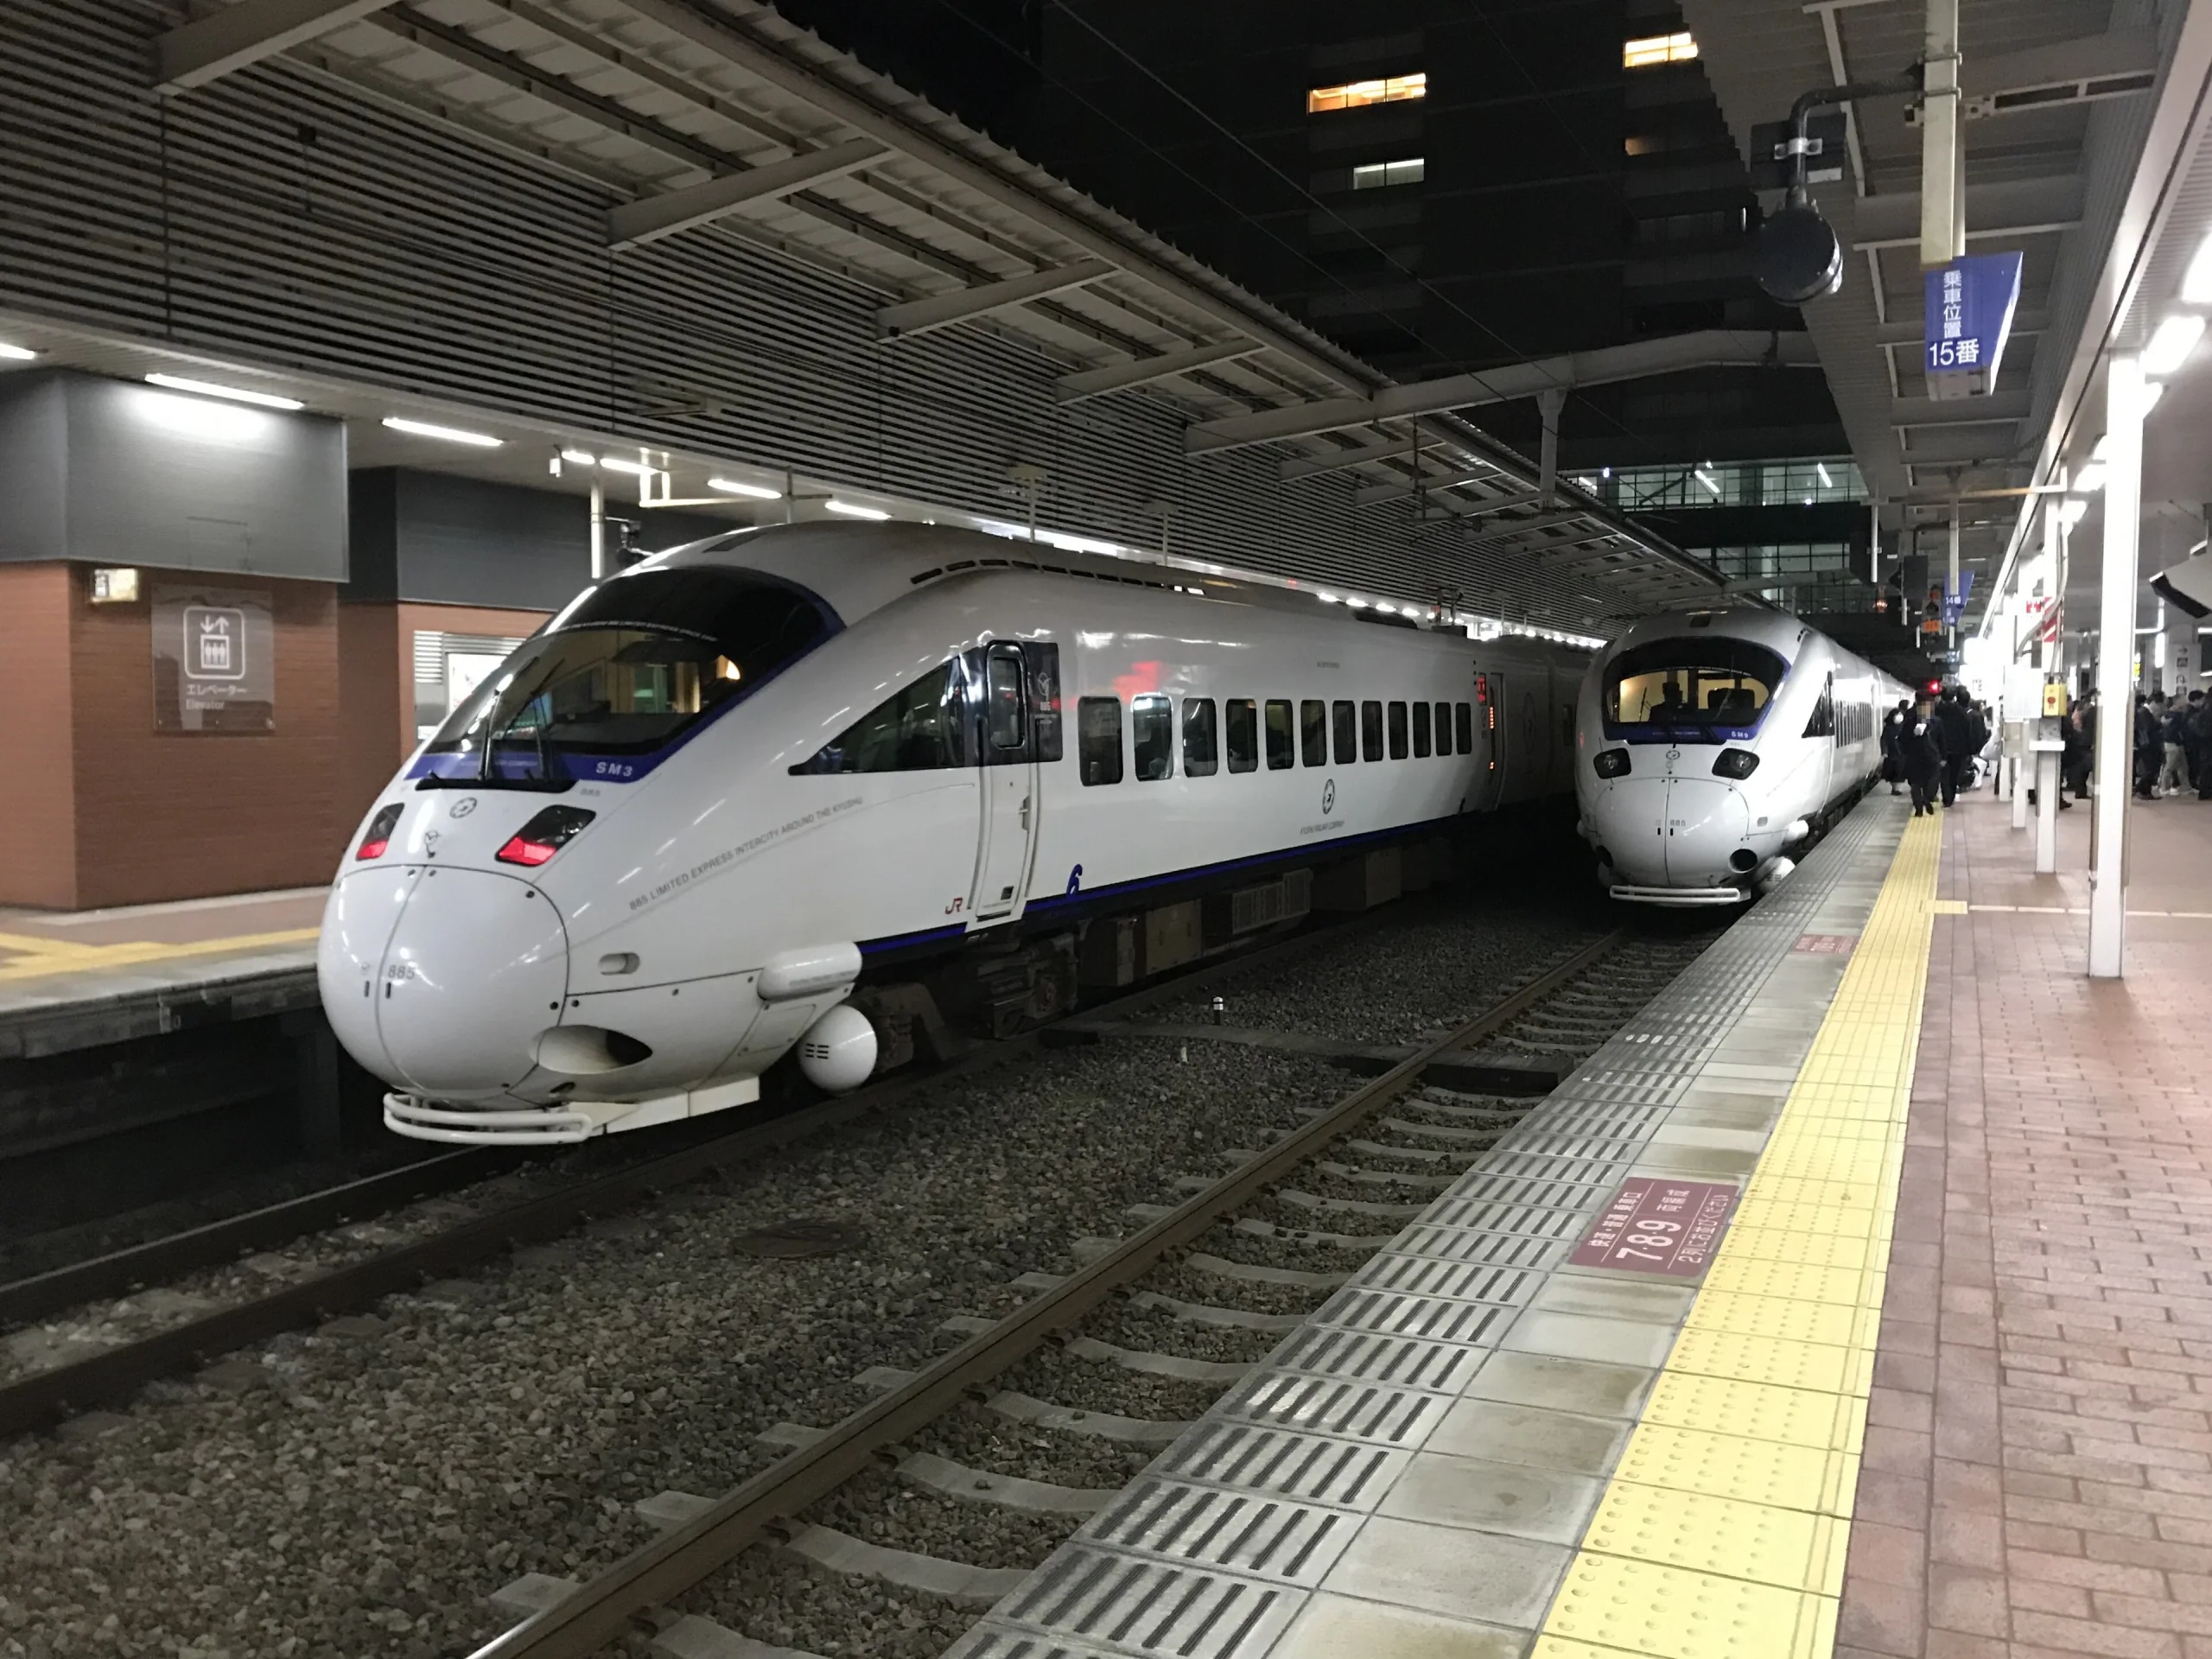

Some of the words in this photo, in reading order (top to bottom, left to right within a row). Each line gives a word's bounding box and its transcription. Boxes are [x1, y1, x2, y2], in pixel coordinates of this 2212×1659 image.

[1943, 270, 1962, 339] 乗車位置
[1929, 338, 1980, 366] 15番
[186, 698, 226, 710] Elevator
[595, 761, 633, 777] SM3
[650, 873, 690, 900] LIMITED
[690, 850, 734, 879] EXPRESS
[781, 813, 815, 835] AROUND
[1065, 863, 1084, 900] 6
[944, 897, 963, 915] JR
[388, 964, 416, 981] 885
